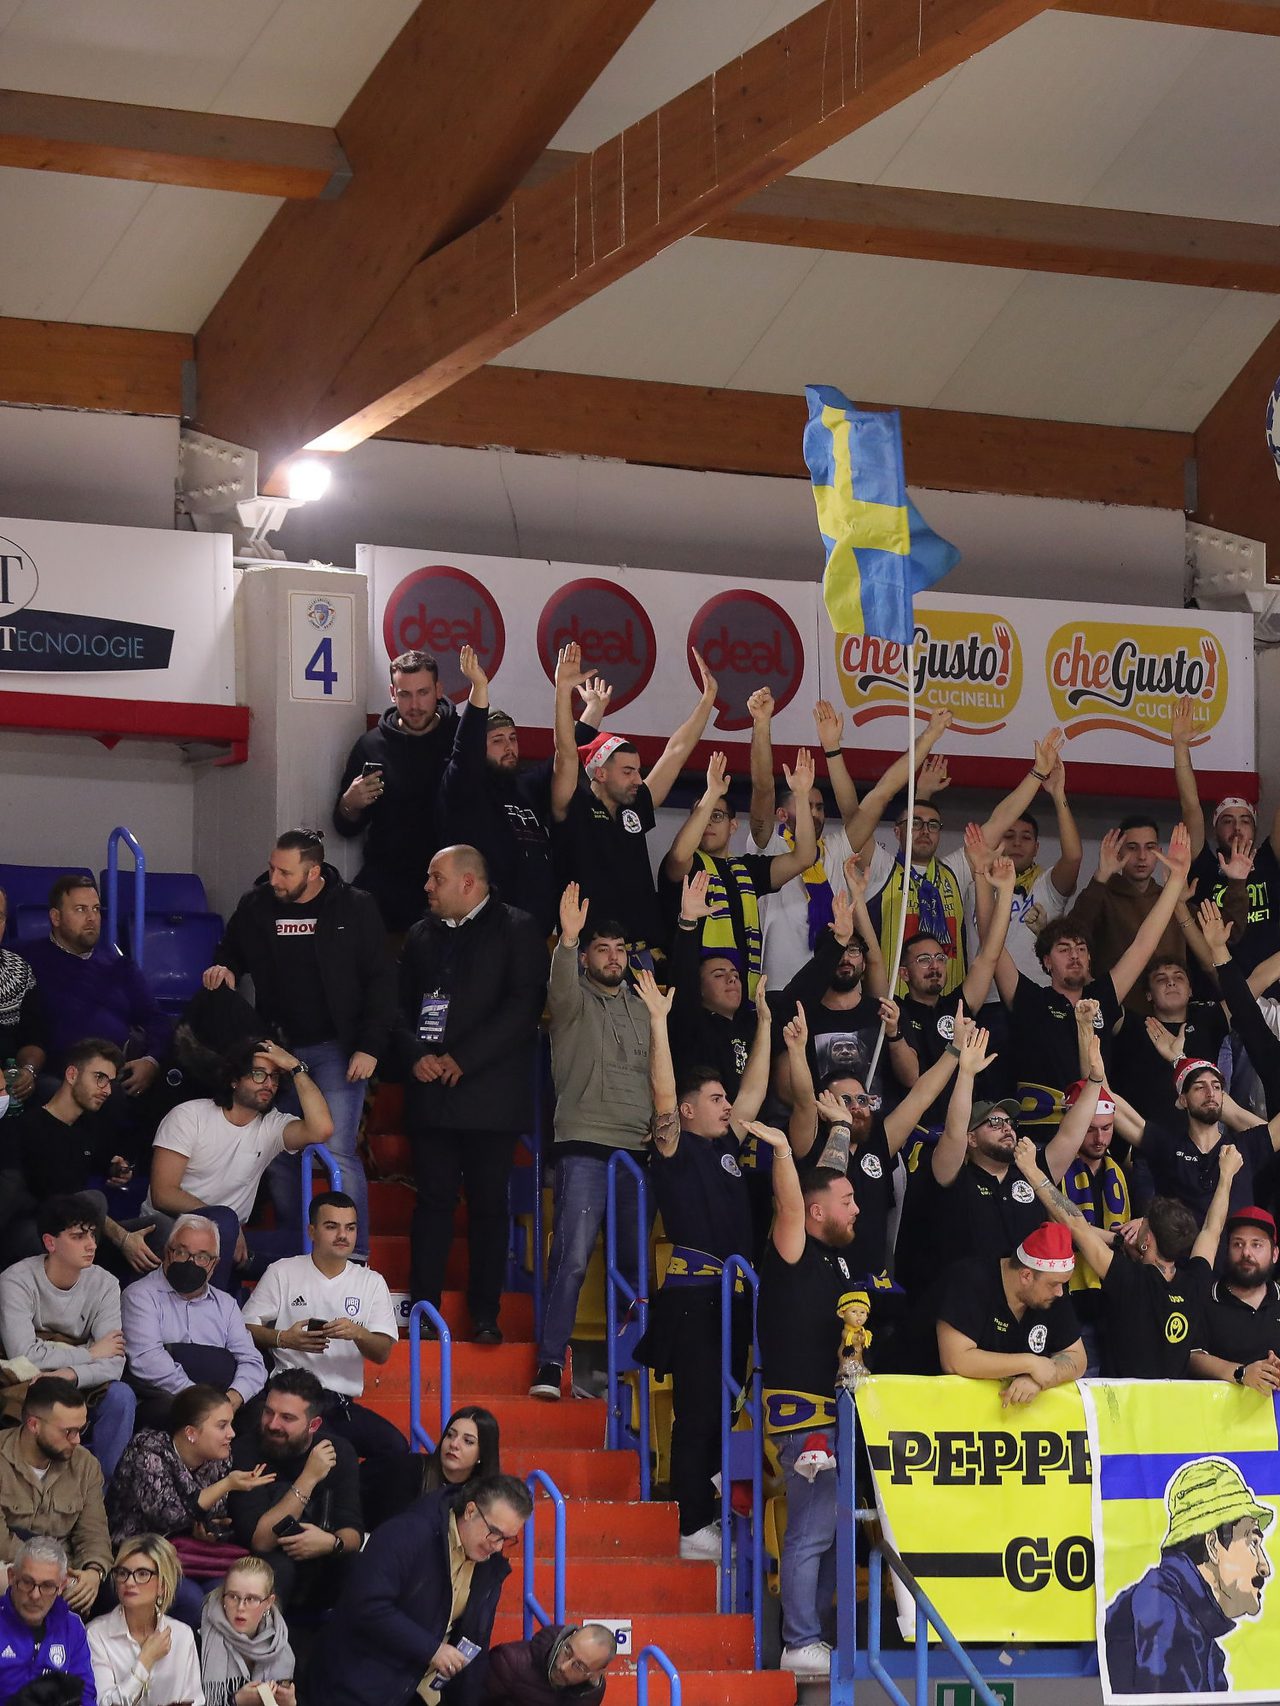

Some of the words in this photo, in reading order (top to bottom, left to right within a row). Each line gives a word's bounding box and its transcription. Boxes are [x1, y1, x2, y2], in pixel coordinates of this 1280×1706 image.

[0, 626, 144, 659] TECNOLOGIE
[400, 603, 489, 655] deal
[552, 614, 640, 666] deal
[703, 626, 790, 678] deal
[305, 637, 338, 694] 4
[928, 689, 1004, 709] CUCINELLI
[1135, 702, 1210, 721] CUCILLI
[1004, 1537, 1094, 1592] CO
